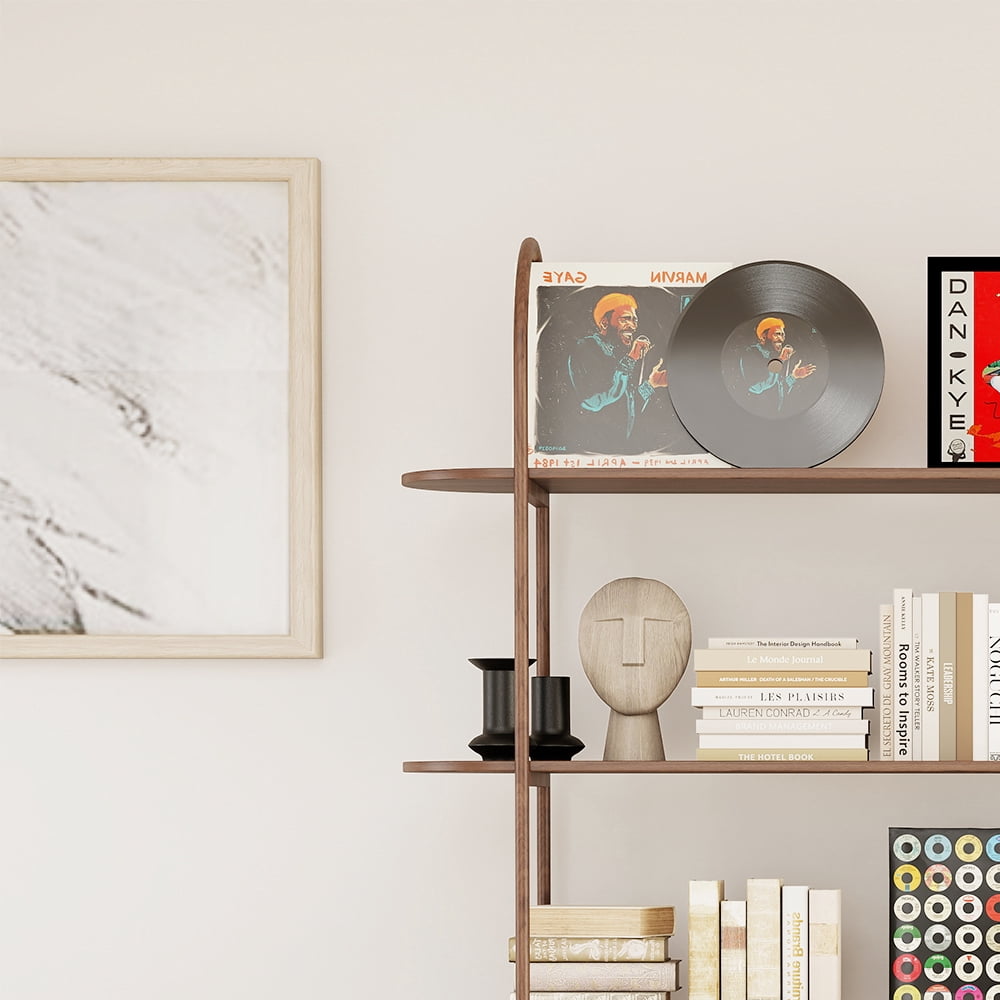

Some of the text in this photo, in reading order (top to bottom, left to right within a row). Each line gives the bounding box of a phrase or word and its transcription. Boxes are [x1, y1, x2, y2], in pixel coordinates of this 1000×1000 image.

[948, 278, 968, 340] DAN
[948, 368, 968, 430] KYE
[747, 656, 824, 664] Le Monde Journal
[883, 614, 892, 757] EL SECRETO DE GRAY MOUNTAIN
[926, 656, 935, 712] KATE MOSS
[720, 708, 763, 718] LAUREN
[766, 708, 810, 718] CONRAD
[760, 692, 845, 702] LES PLAISIRS
[896, 644, 910, 756] Rooms to Inspire
